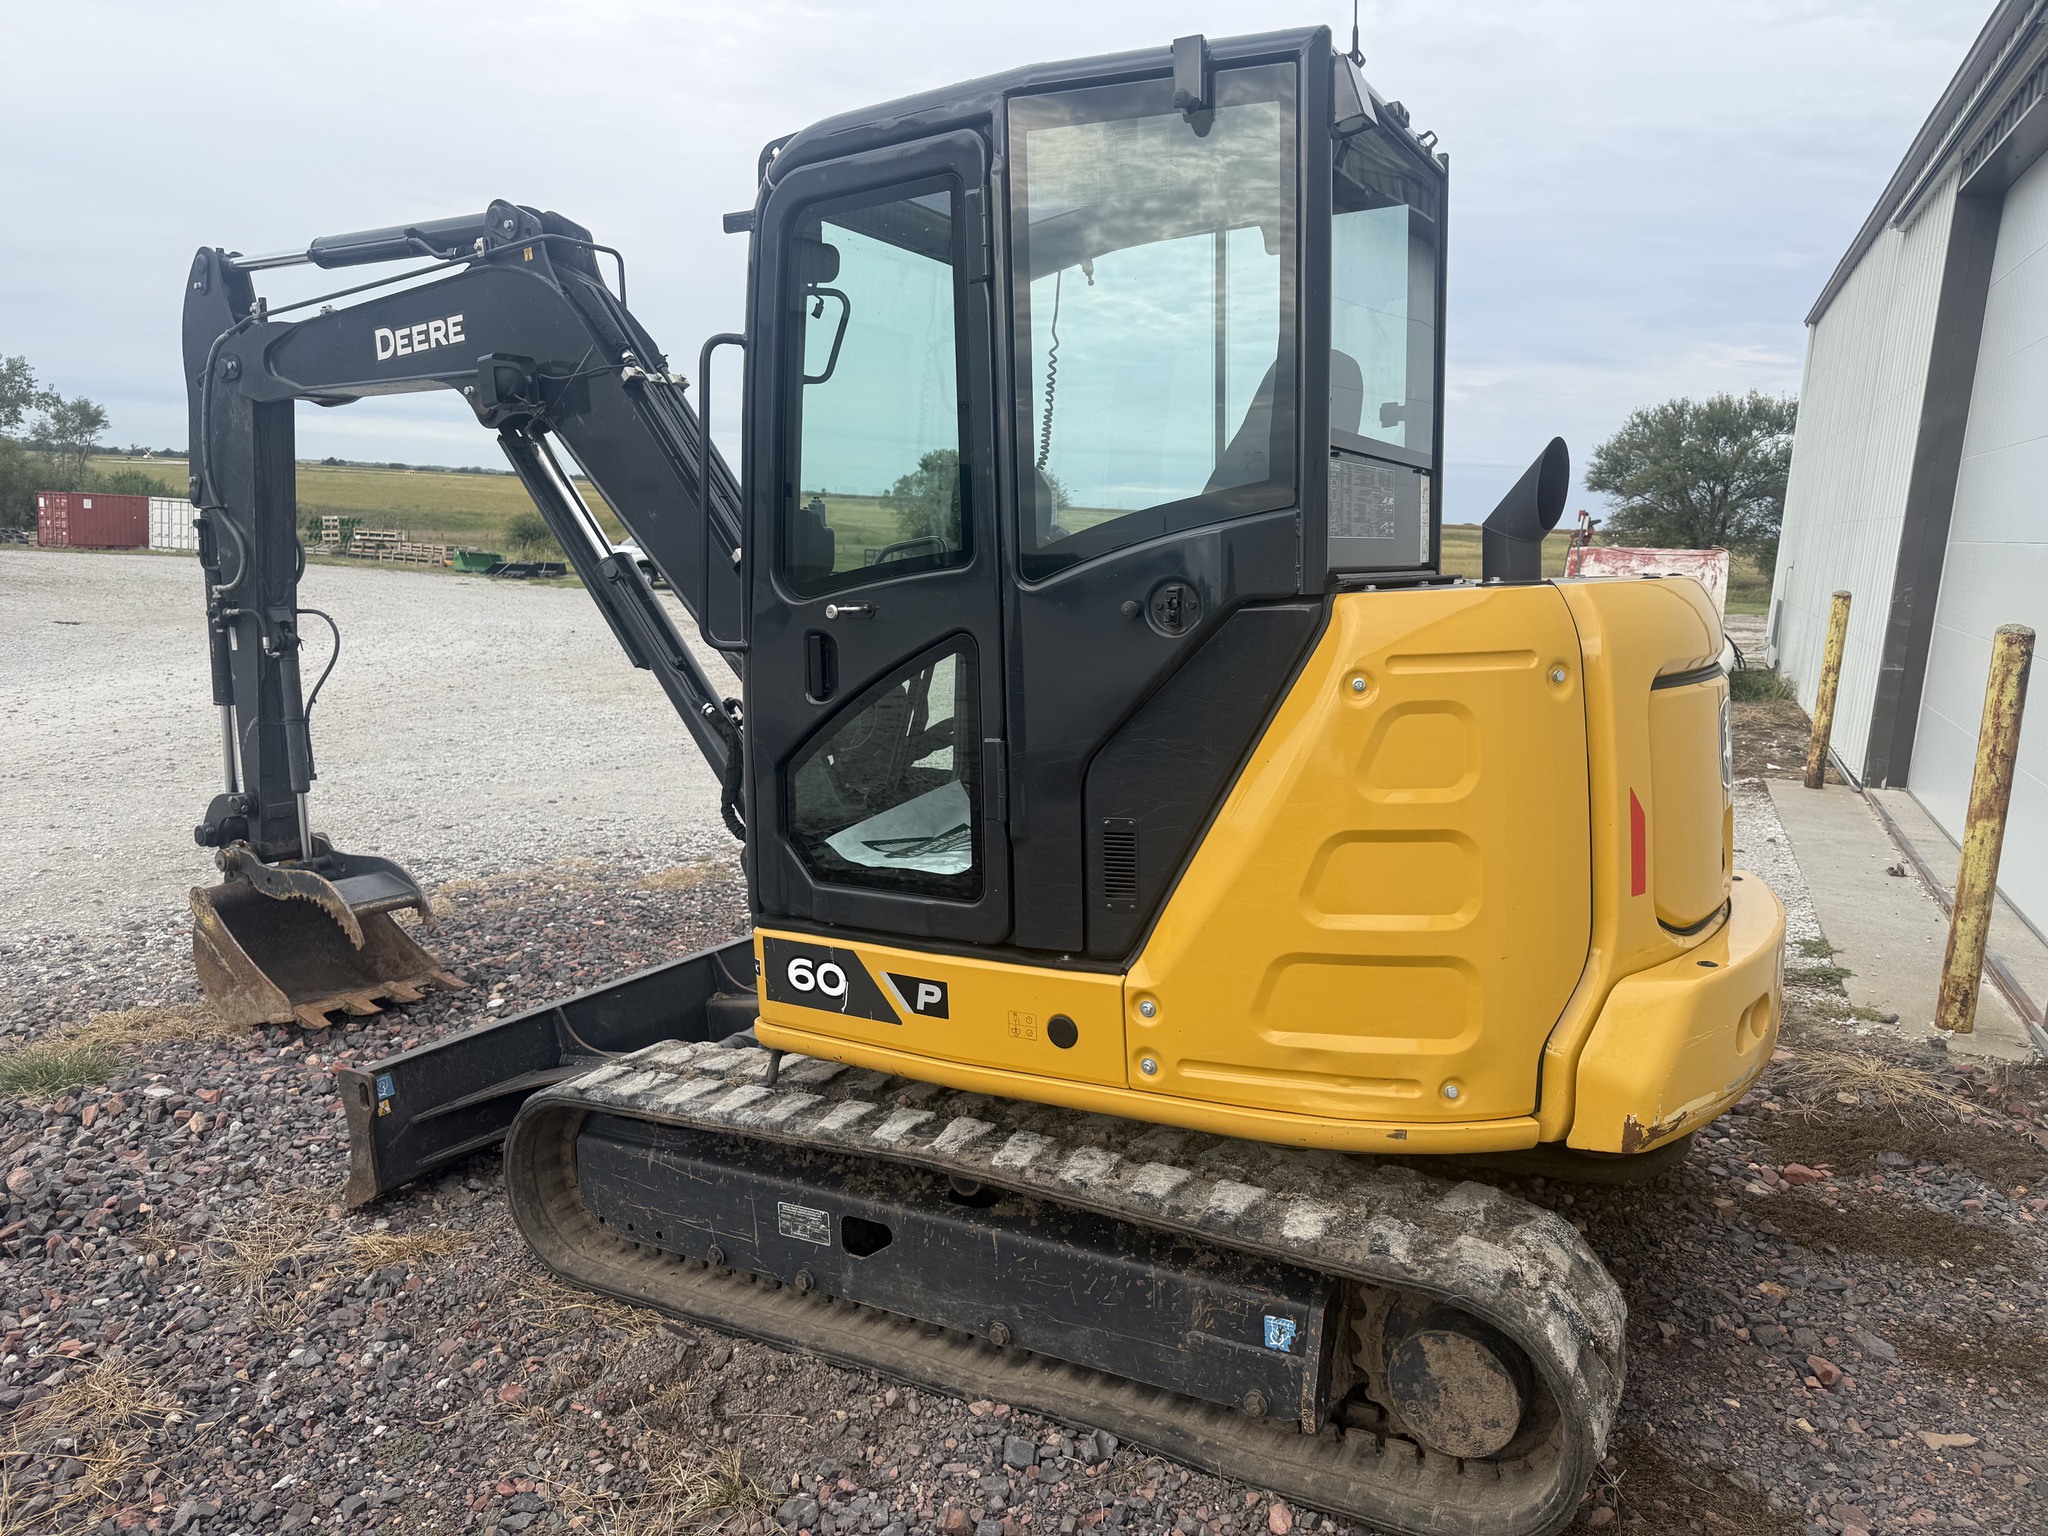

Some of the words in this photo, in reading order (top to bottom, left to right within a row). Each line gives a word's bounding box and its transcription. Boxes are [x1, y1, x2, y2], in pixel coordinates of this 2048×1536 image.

[374, 314, 466, 361] DEERE
[787, 957, 847, 997] 60
[916, 983, 942, 1011] P
